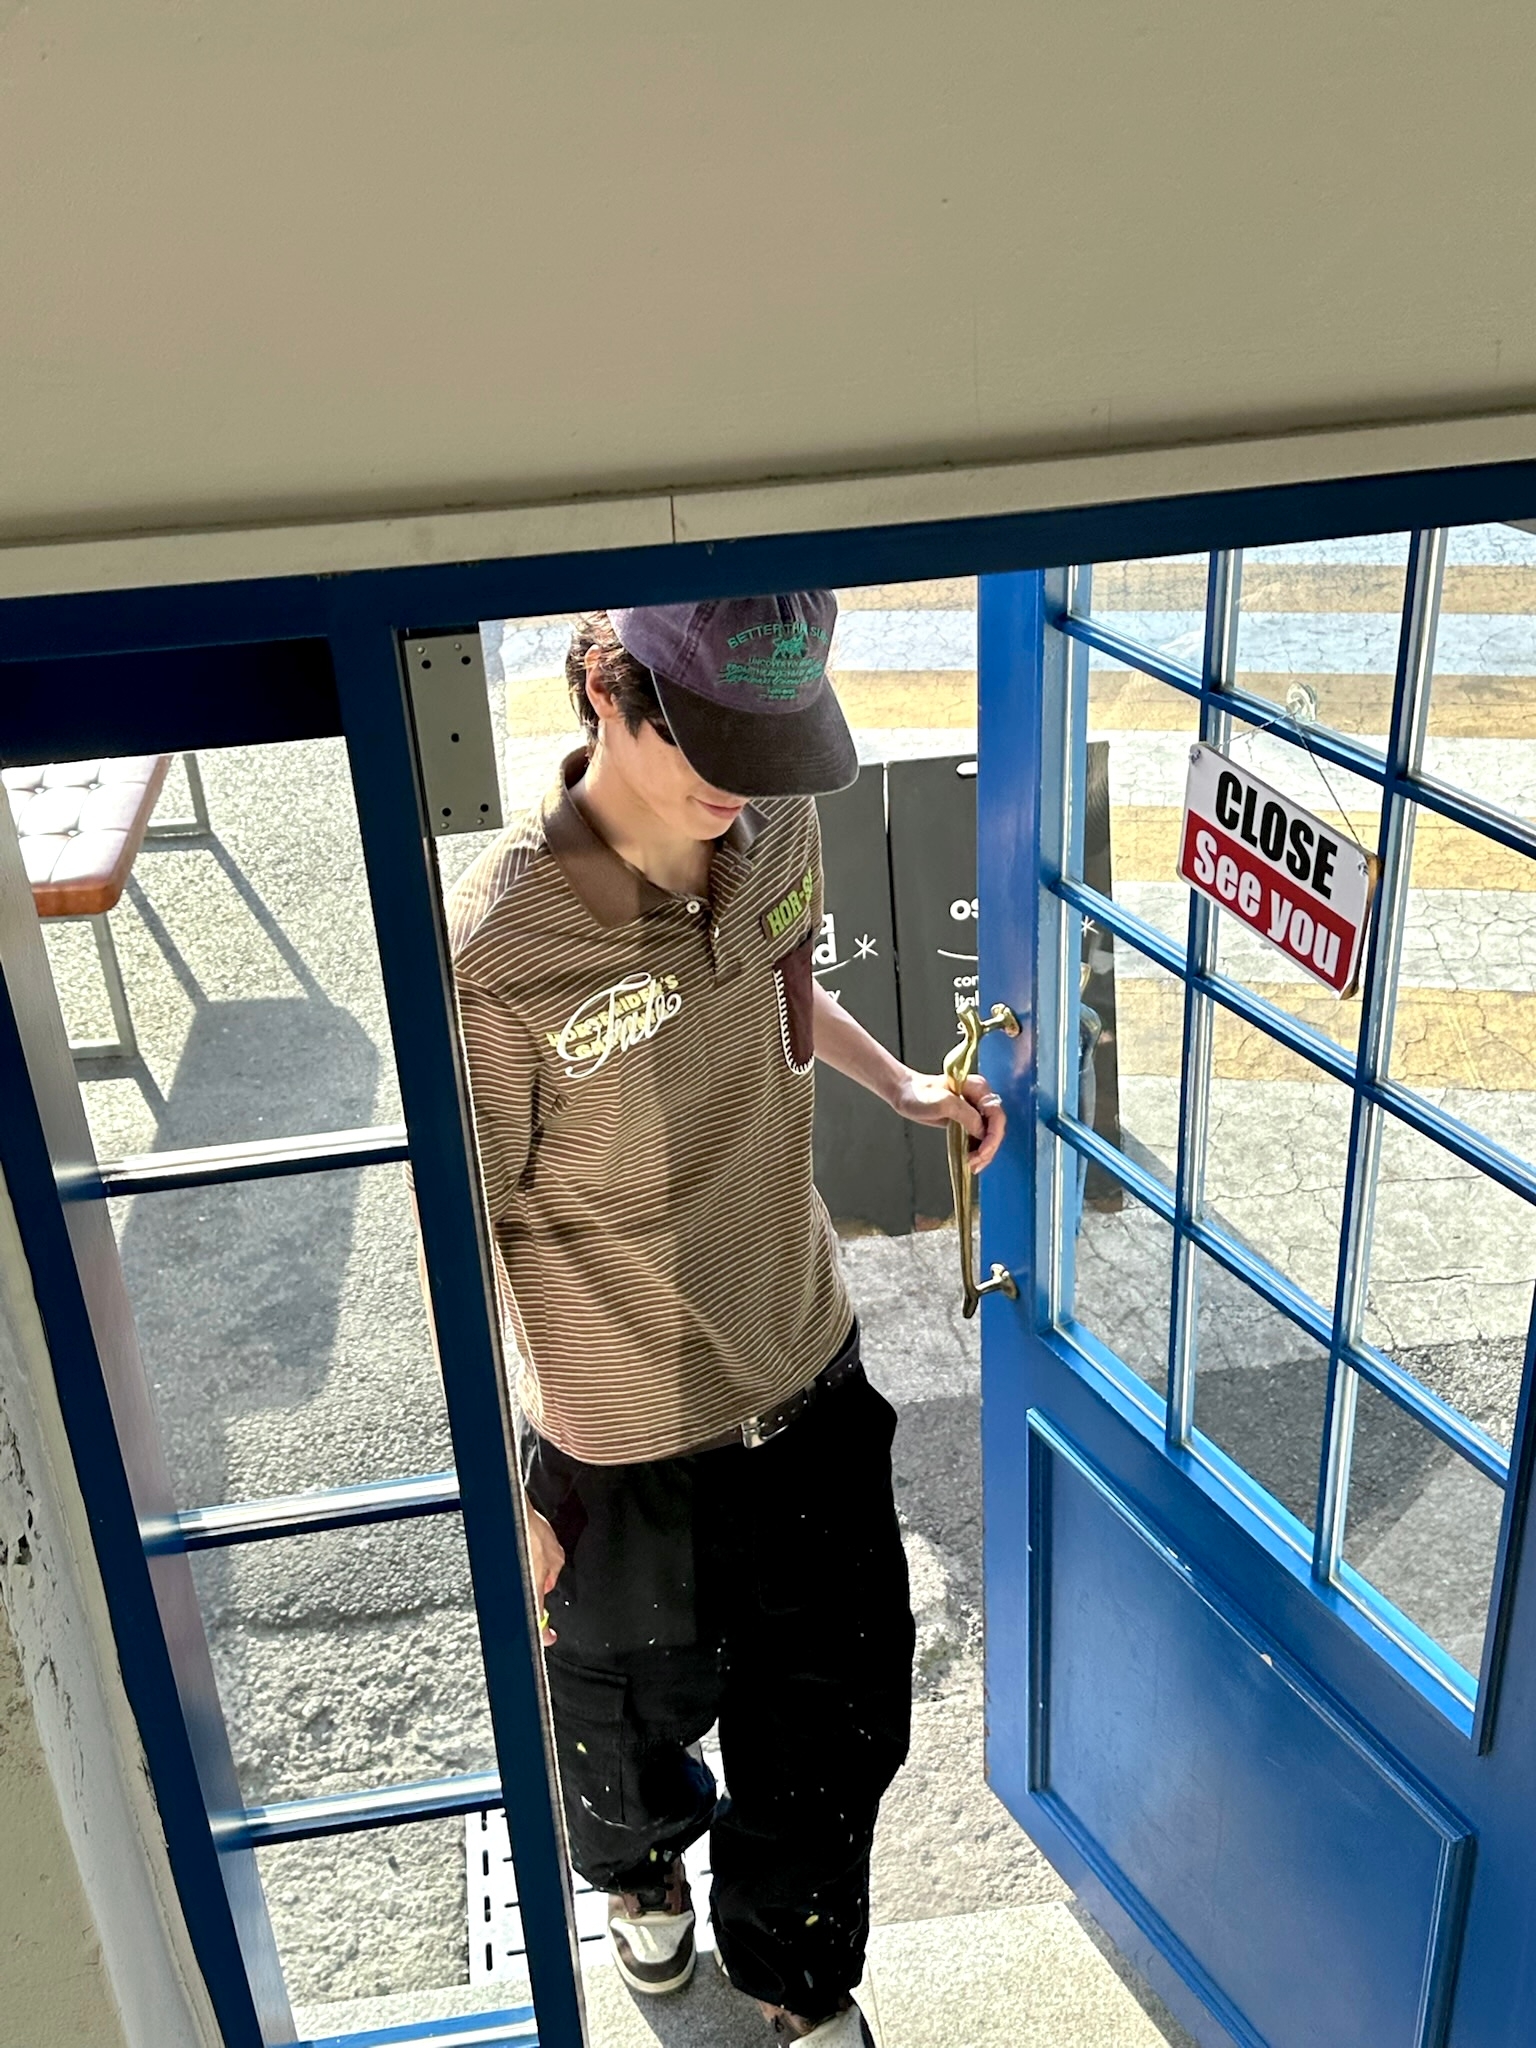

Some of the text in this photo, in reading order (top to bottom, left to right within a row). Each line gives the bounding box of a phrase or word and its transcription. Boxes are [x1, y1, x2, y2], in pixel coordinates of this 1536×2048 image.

[727, 623, 782, 649] BETTER
[1215, 770, 1338, 900] CLOSE
[1193, 829, 1341, 979] See you
